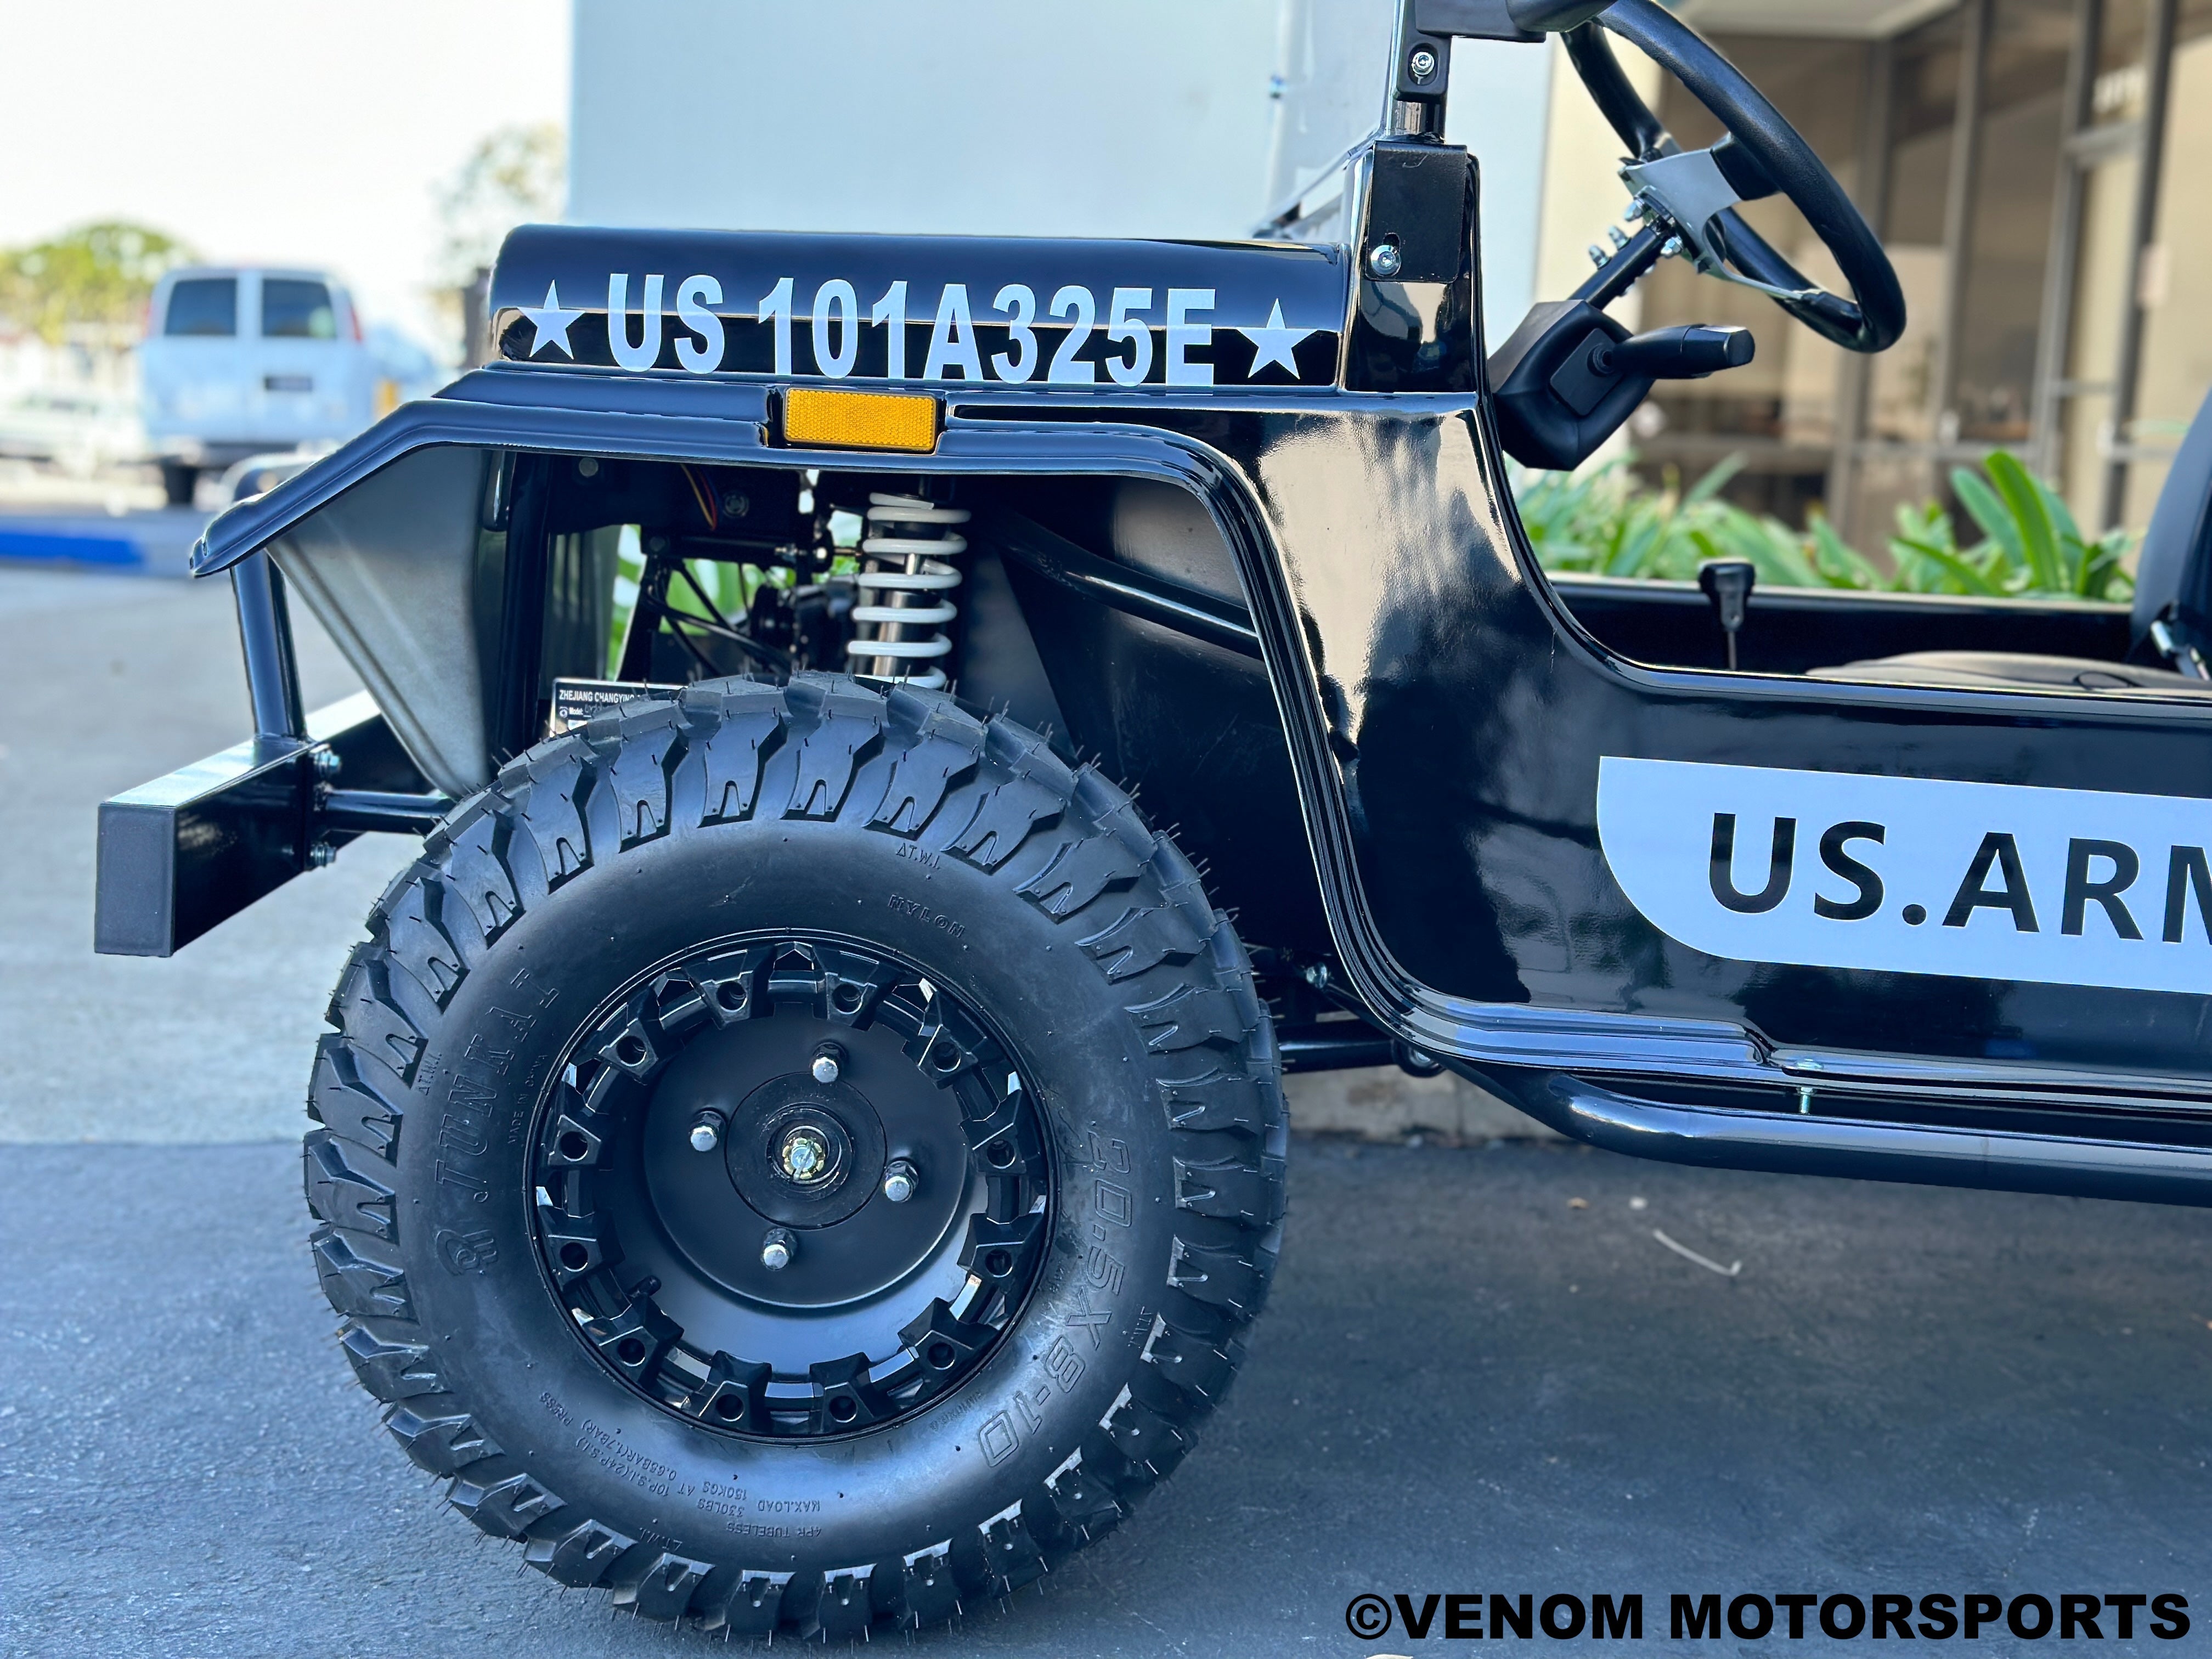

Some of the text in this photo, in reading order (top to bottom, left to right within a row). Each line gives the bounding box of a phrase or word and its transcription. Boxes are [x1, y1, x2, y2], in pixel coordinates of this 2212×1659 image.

[608, 273, 1216, 387] US 101A325E
[558, 689, 593, 702] ZHEJIANG
[887, 894, 966, 938] NYLON
[676, 1482, 696, 1497] AT
[726, 1522, 790, 1538] TUBELESS
